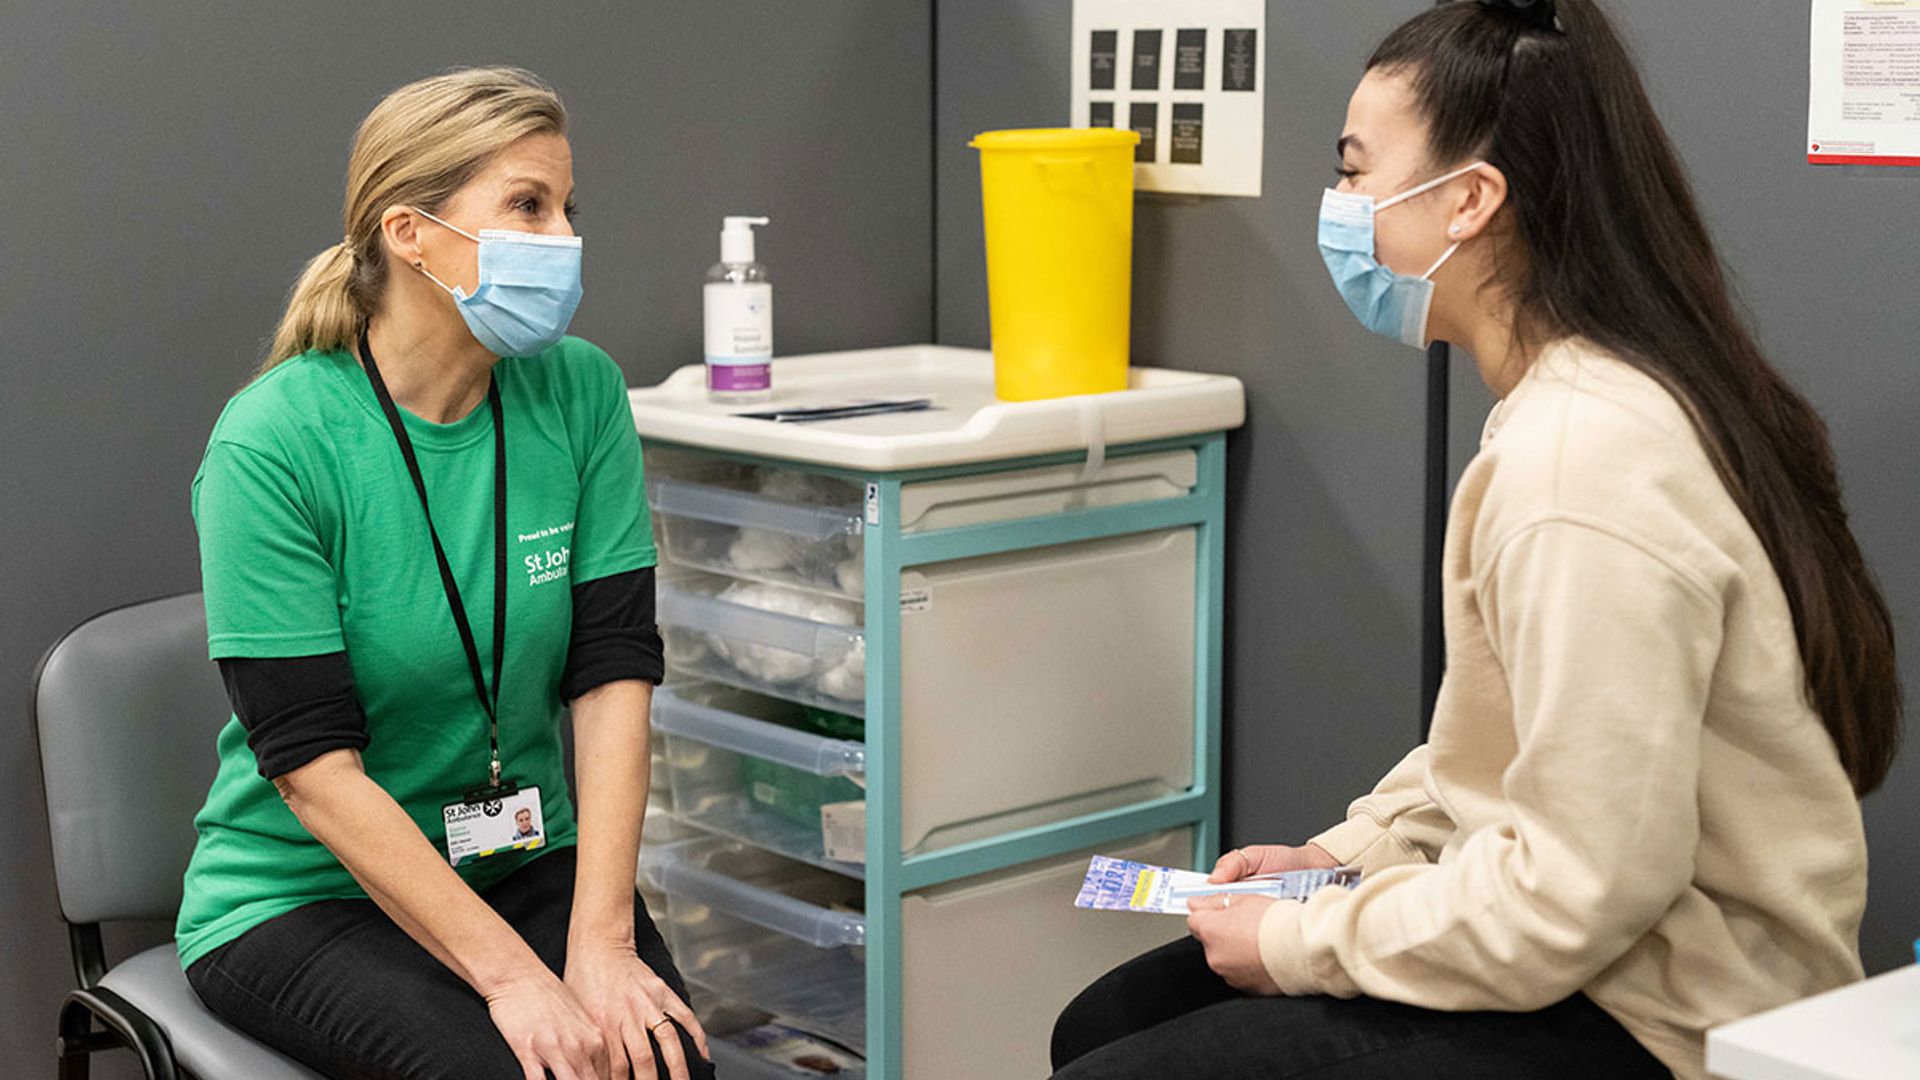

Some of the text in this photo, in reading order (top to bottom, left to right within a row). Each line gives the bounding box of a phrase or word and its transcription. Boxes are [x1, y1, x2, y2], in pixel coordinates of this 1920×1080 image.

[518, 530, 540, 543] Proud
[549, 527, 559, 535] be
[524, 553, 544, 574] St
[446, 804, 480, 818] St John
